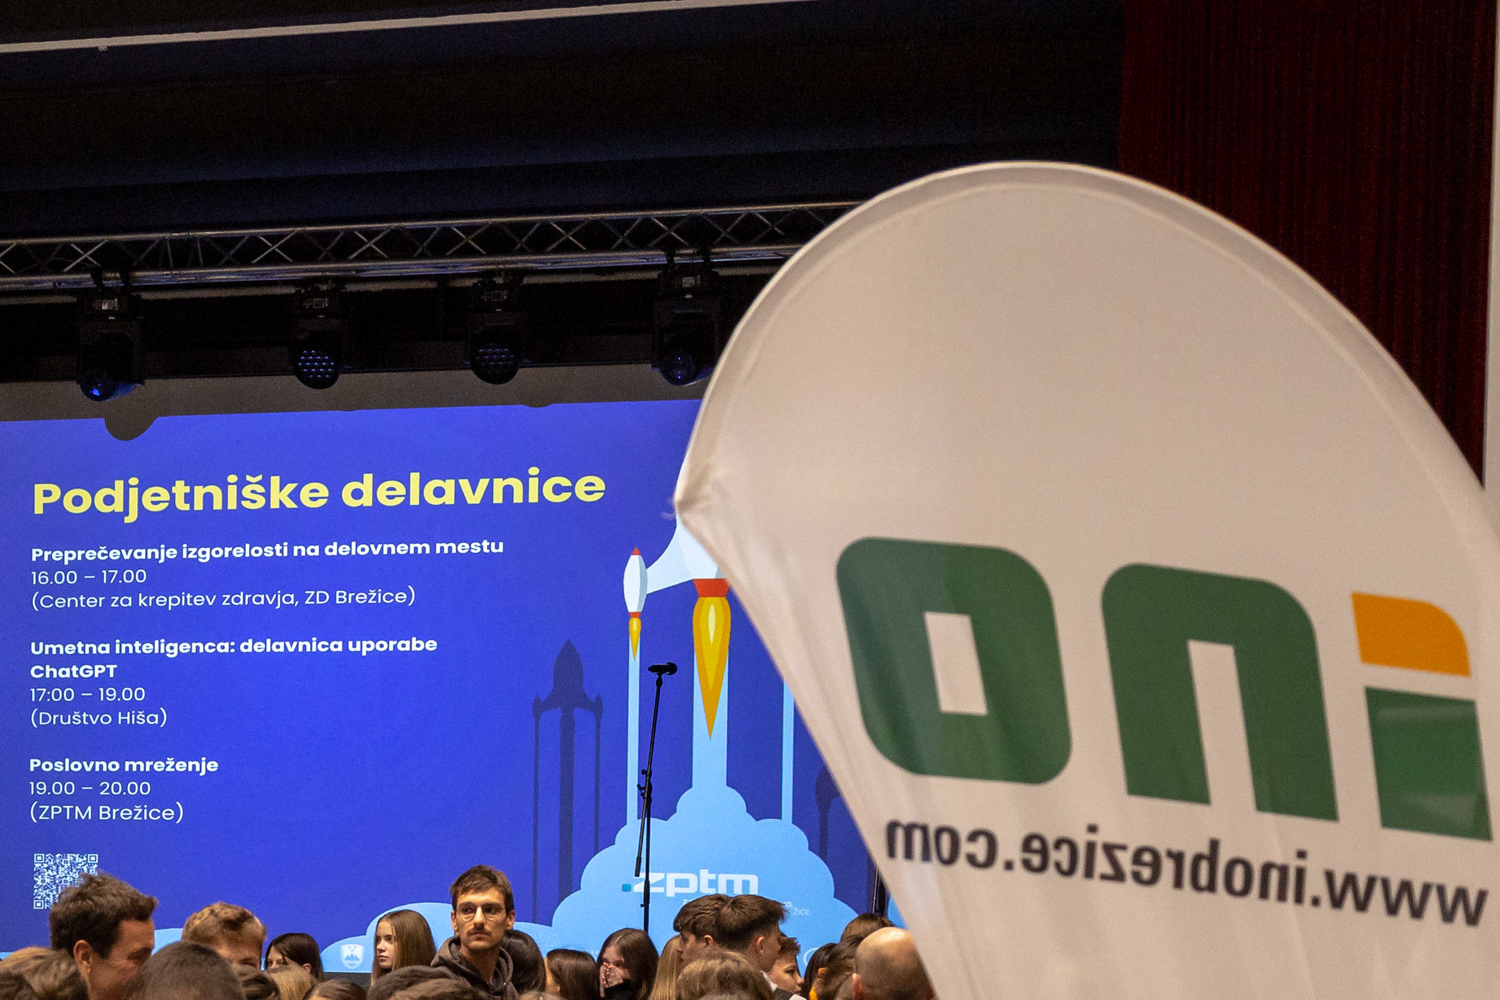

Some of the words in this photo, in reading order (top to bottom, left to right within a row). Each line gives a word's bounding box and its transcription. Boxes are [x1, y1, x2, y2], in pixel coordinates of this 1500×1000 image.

[33, 474, 329, 523] Podjetniške
[341, 467, 606, 507] delavnice
[31, 544, 178, 565] Preprečevanje
[182, 542, 289, 563] izgorelosti
[293, 545, 320, 557] na
[324, 541, 430, 556] delovnem
[435, 539, 504, 554] mestu
[31, 570, 77, 585] 16.00
[101, 569, 147, 584] 17.00
[32, 591, 105, 611] (Center
[110, 594, 133, 608] za
[138, 591, 216, 610] krepitev
[222, 590, 299, 609] zdravja,
[305, 590, 330, 605] ZD
[335, 585, 416, 606] Brežice)
[30, 641, 110, 655] Umetna
[115, 639, 235, 658] inteligenca:
[239, 637, 343, 652] delavnica
[348, 637, 438, 656] uporabe
[30, 664, 117, 678] ChatGPT
[30, 687, 75, 702] 17:00
[99, 687, 146, 701] 19.00
[31, 708, 112, 728] (Društvo
[117, 707, 167, 728] Hiša)
[29, 758, 120, 772] Poslovno
[124, 757, 219, 776] mreženje
[29, 781, 75, 796] 19.00
[99, 781, 150, 796] 20.00
[30, 801, 92, 823] (ZPTM
[98, 801, 184, 823] Brežice)
[632, 868, 758, 897] zptm
